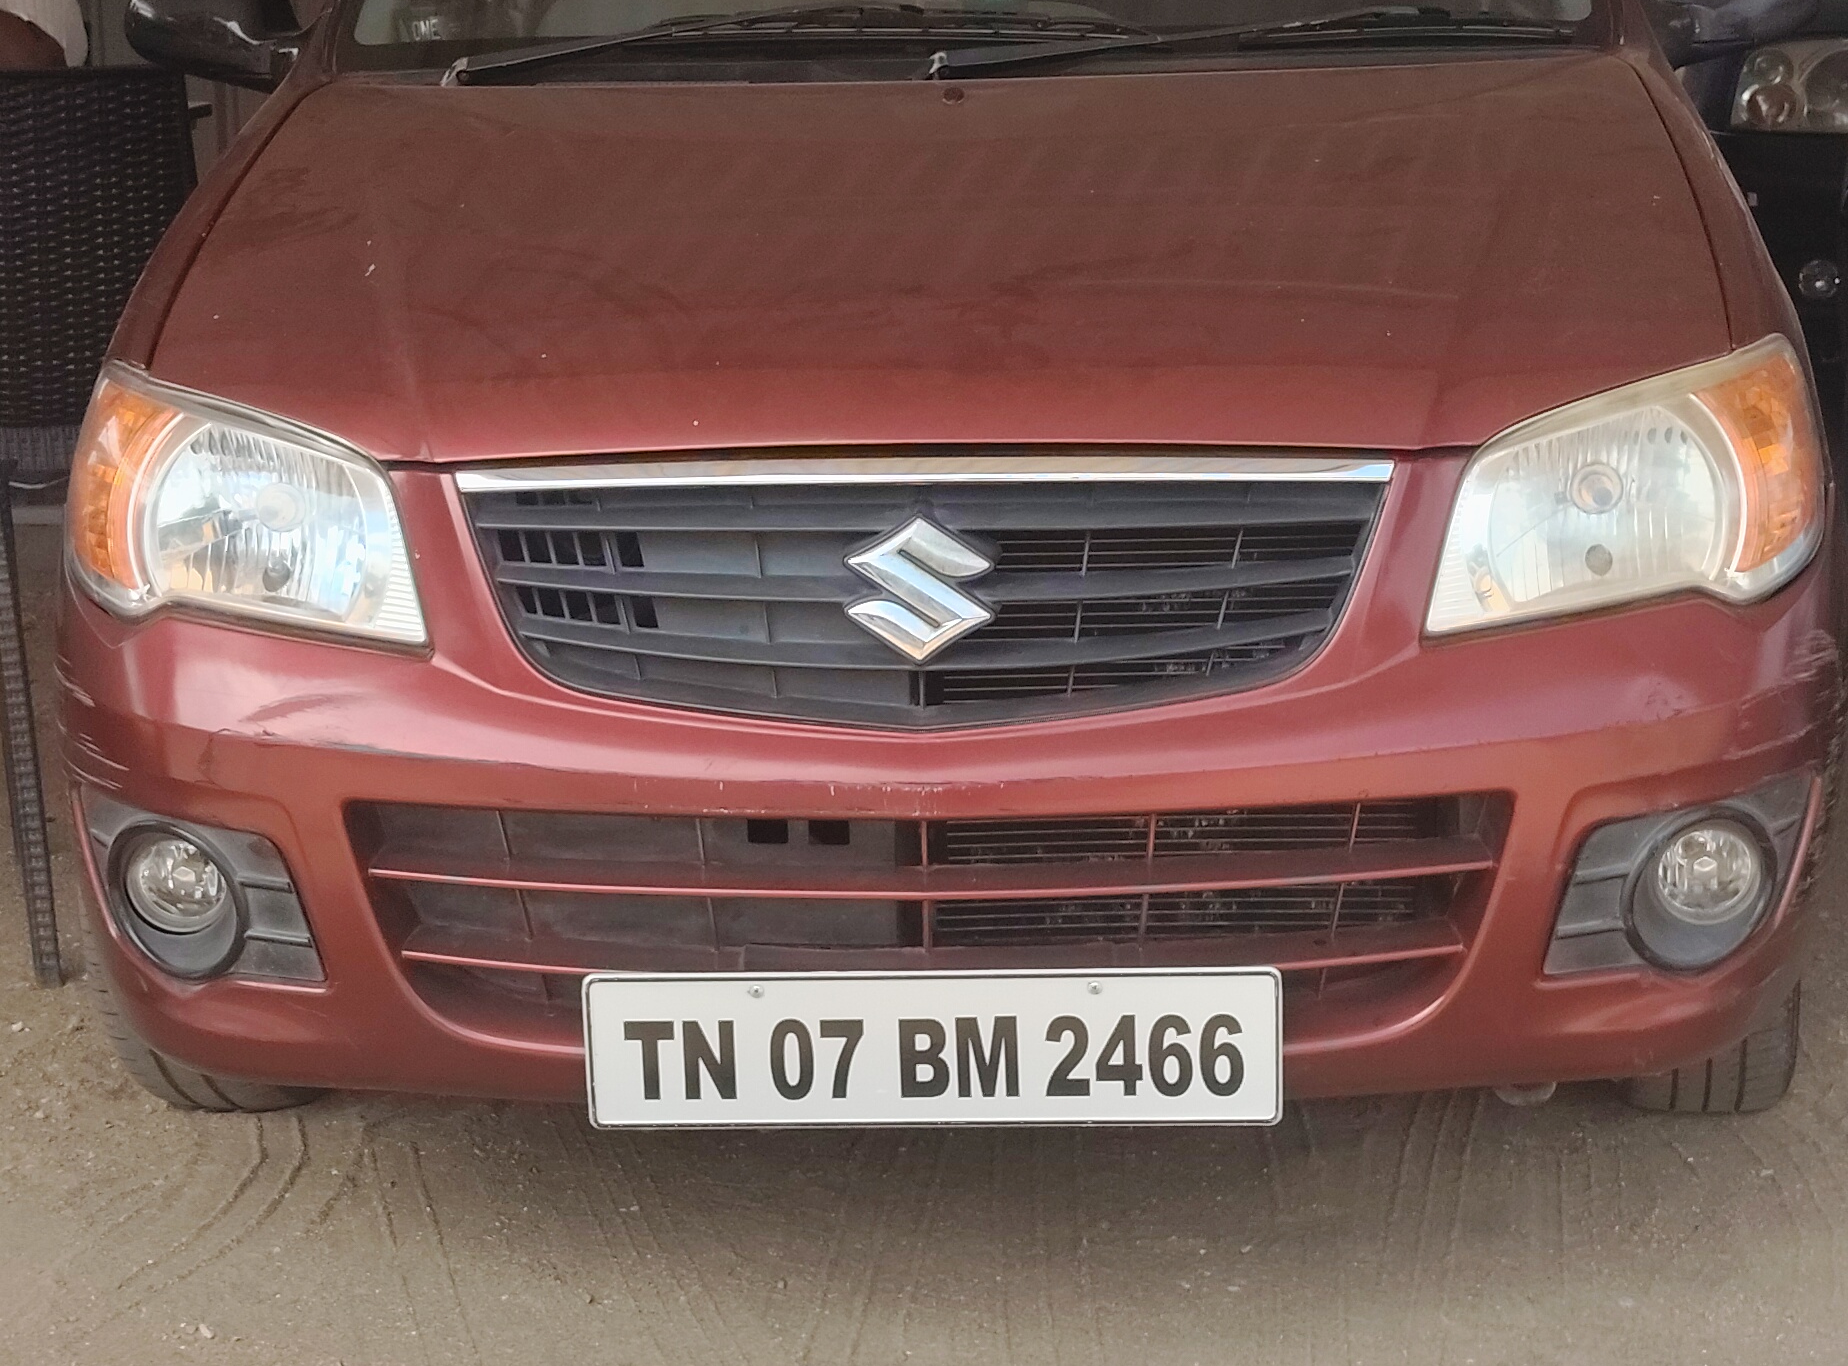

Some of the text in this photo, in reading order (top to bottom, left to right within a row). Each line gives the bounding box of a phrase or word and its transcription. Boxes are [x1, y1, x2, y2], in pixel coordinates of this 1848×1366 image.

[624, 1014, 1243, 1100] TN 07 BM 2466
